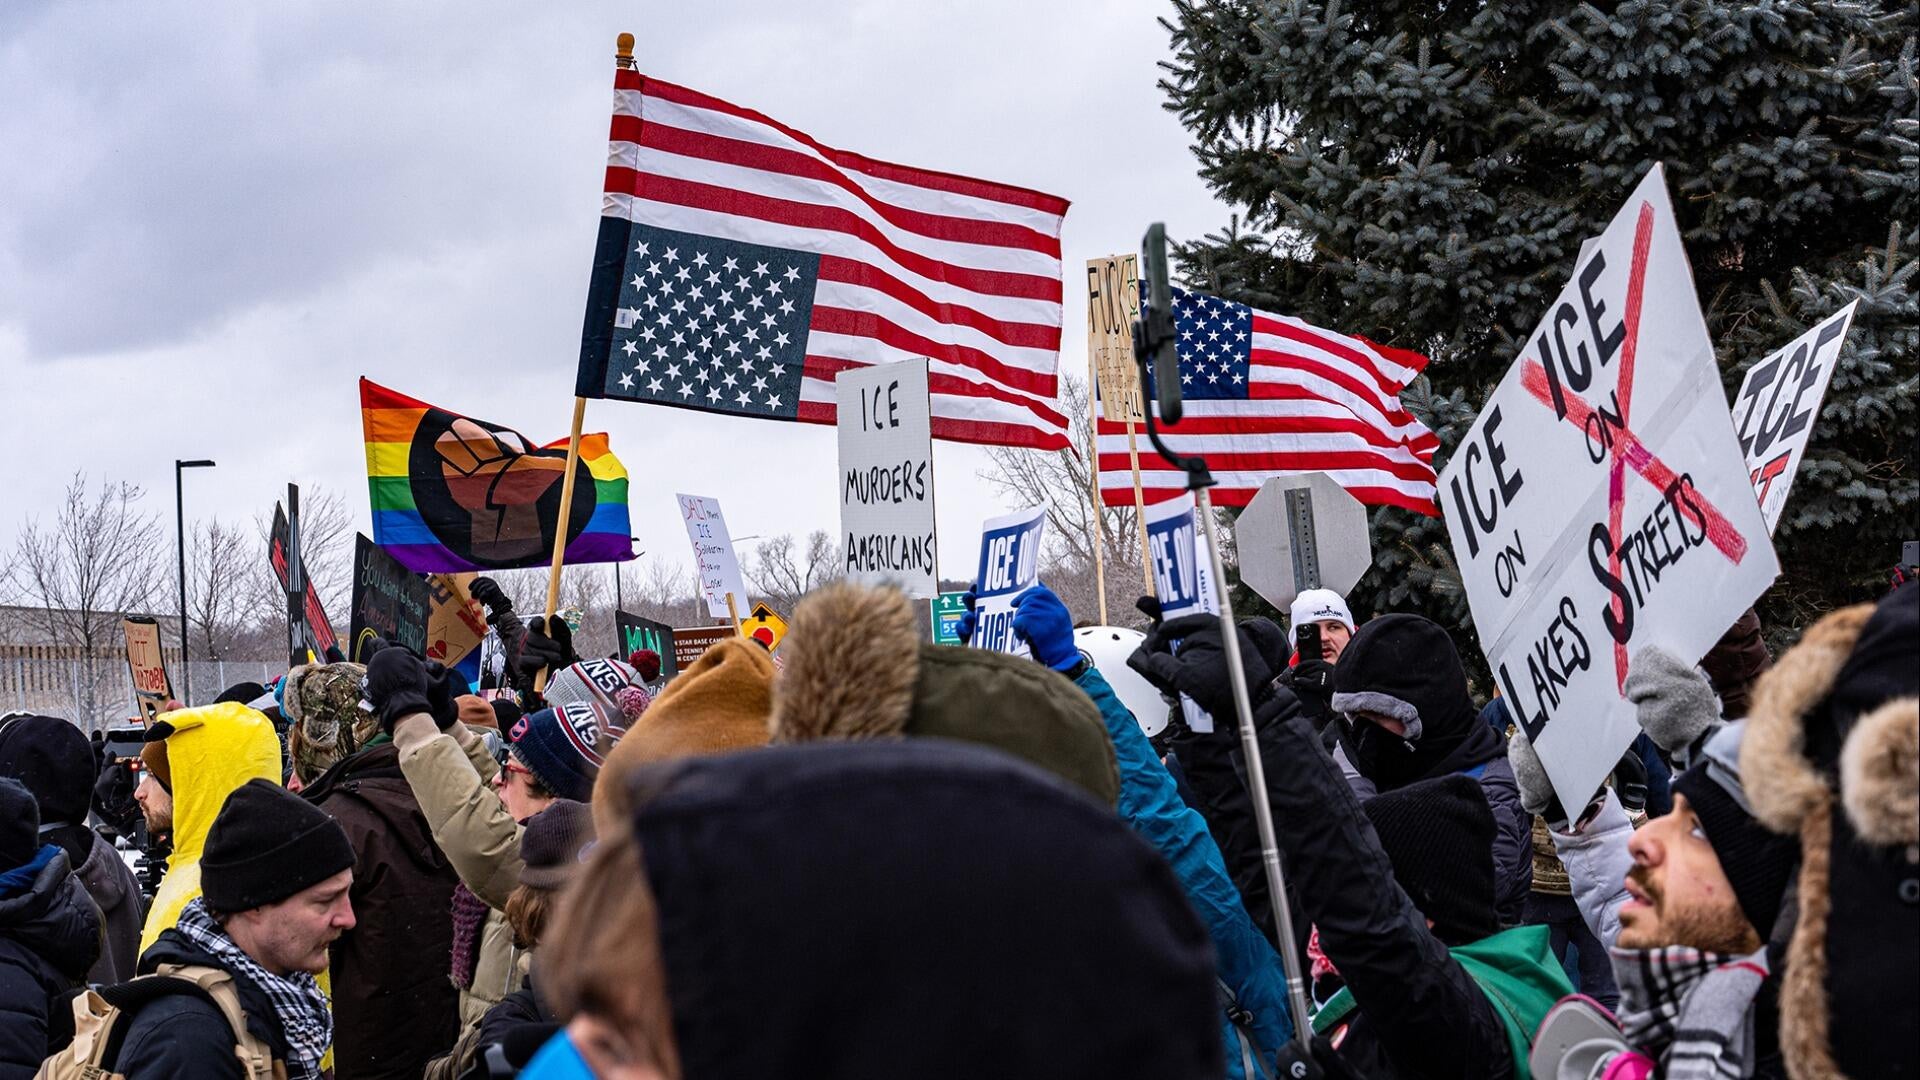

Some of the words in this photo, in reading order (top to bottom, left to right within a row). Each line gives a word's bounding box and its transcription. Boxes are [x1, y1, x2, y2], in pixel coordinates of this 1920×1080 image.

[1088, 261, 1131, 336] FUCK
[1537, 249, 1627, 422] ICE
[861, 380, 899, 432] ICE
[1123, 391, 1142, 418] ALL
[1738, 313, 1848, 460] ICE
[1585, 389, 1625, 464] ON
[681, 496, 707, 520] SALT
[846, 460, 927, 505] MURDERS
[1451, 404, 1524, 560] ICE
[696, 523, 712, 538] ICE
[847, 532, 933, 577] AMERICANS
[1588, 473, 1707, 645] STREETS
[984, 535, 1016, 592] ICE
[1495, 530, 1526, 598] ON
[678, 638, 693, 646] STAR
[693, 637, 708, 646] BASE
[683, 647, 704, 655] TENNIS
[1500, 596, 1591, 745] LAKES
